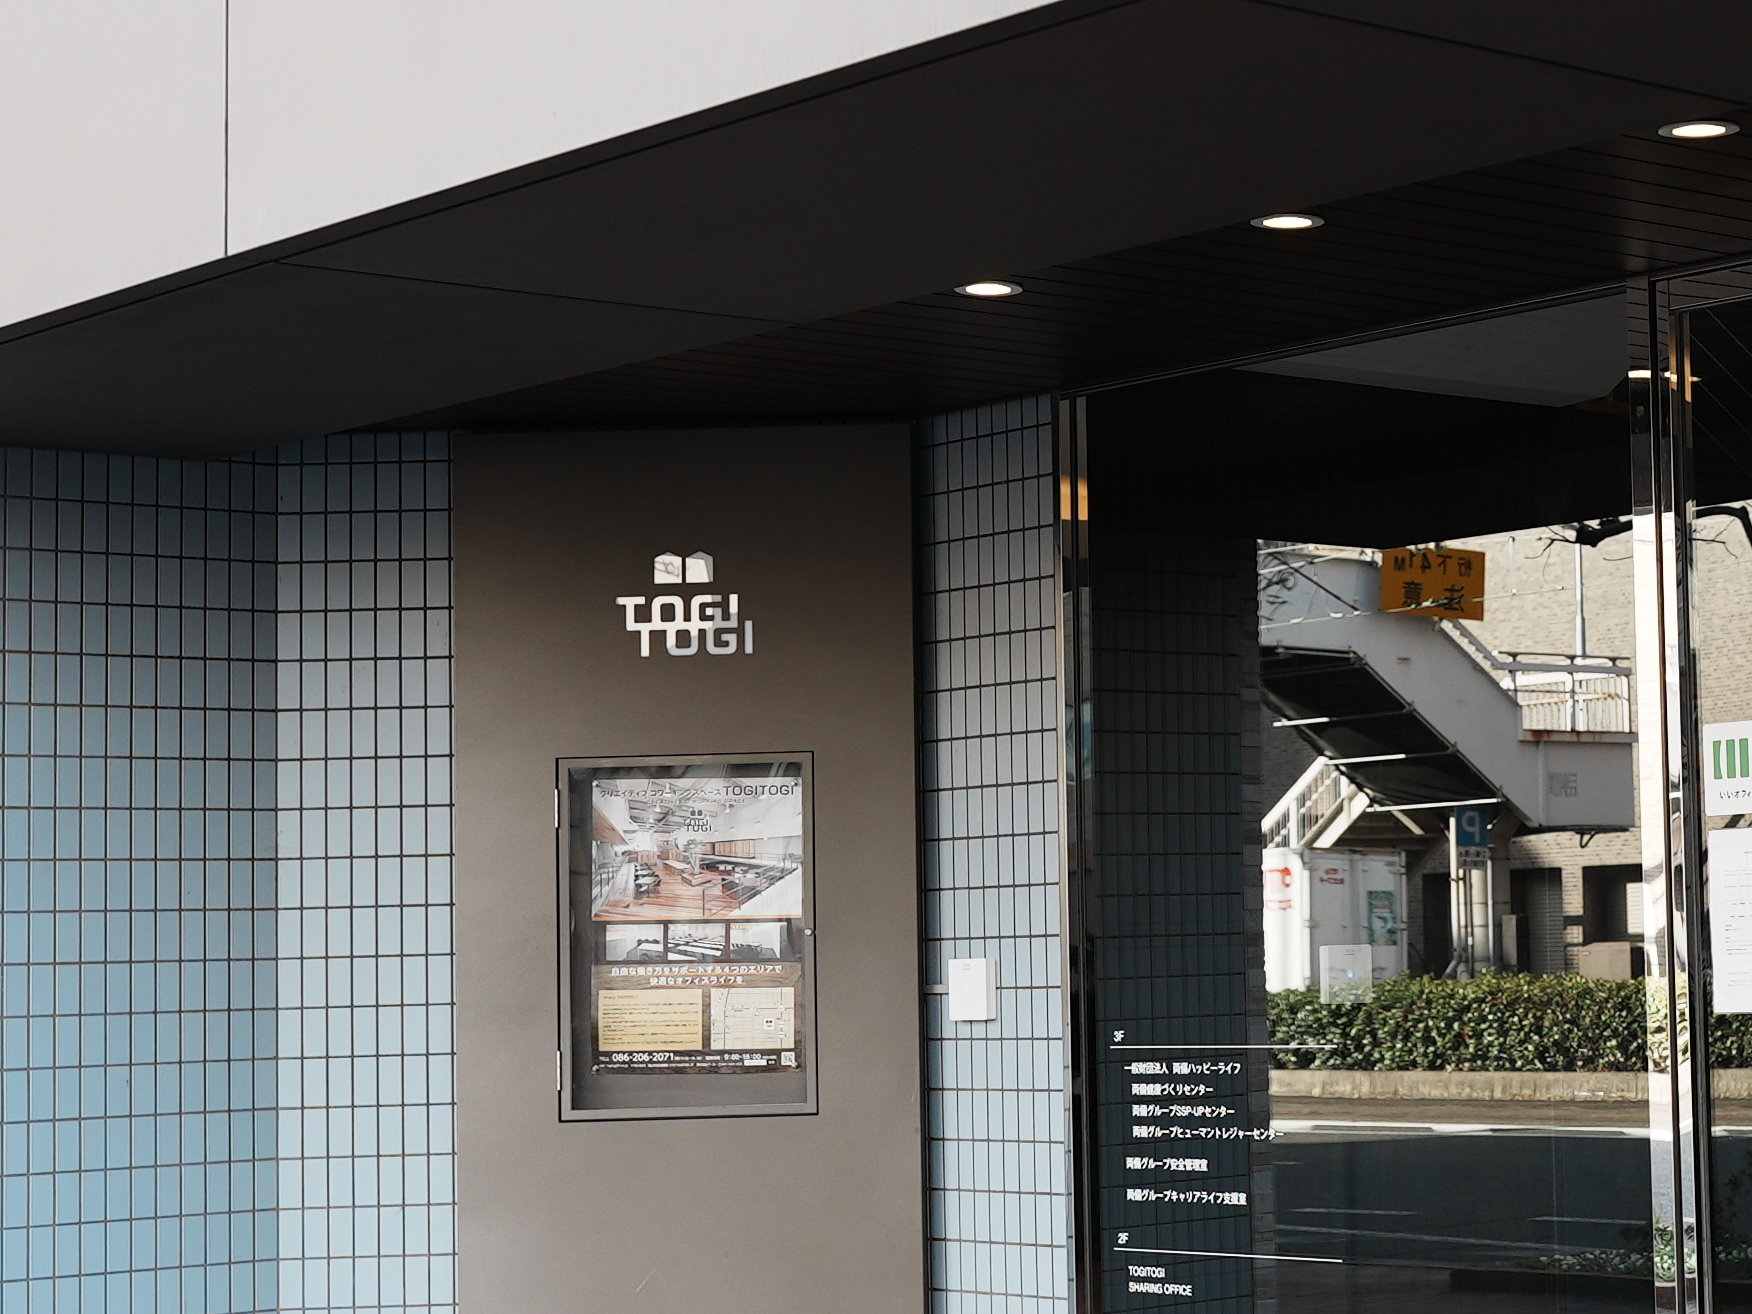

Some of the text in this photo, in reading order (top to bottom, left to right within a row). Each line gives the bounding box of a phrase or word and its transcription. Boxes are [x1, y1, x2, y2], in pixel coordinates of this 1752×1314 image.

[614, 593, 739, 631] TOGI
[626, 619, 753, 657] TOGI
[723, 784, 795, 798] TOGITOGI
[1113, 1030, 1125, 1043] 3F
[1117, 1232, 1130, 1245] 2F
[1128, 1265, 1166, 1278] TOGITOGI
[1128, 1281, 1193, 1296] SHARING OFFICE
